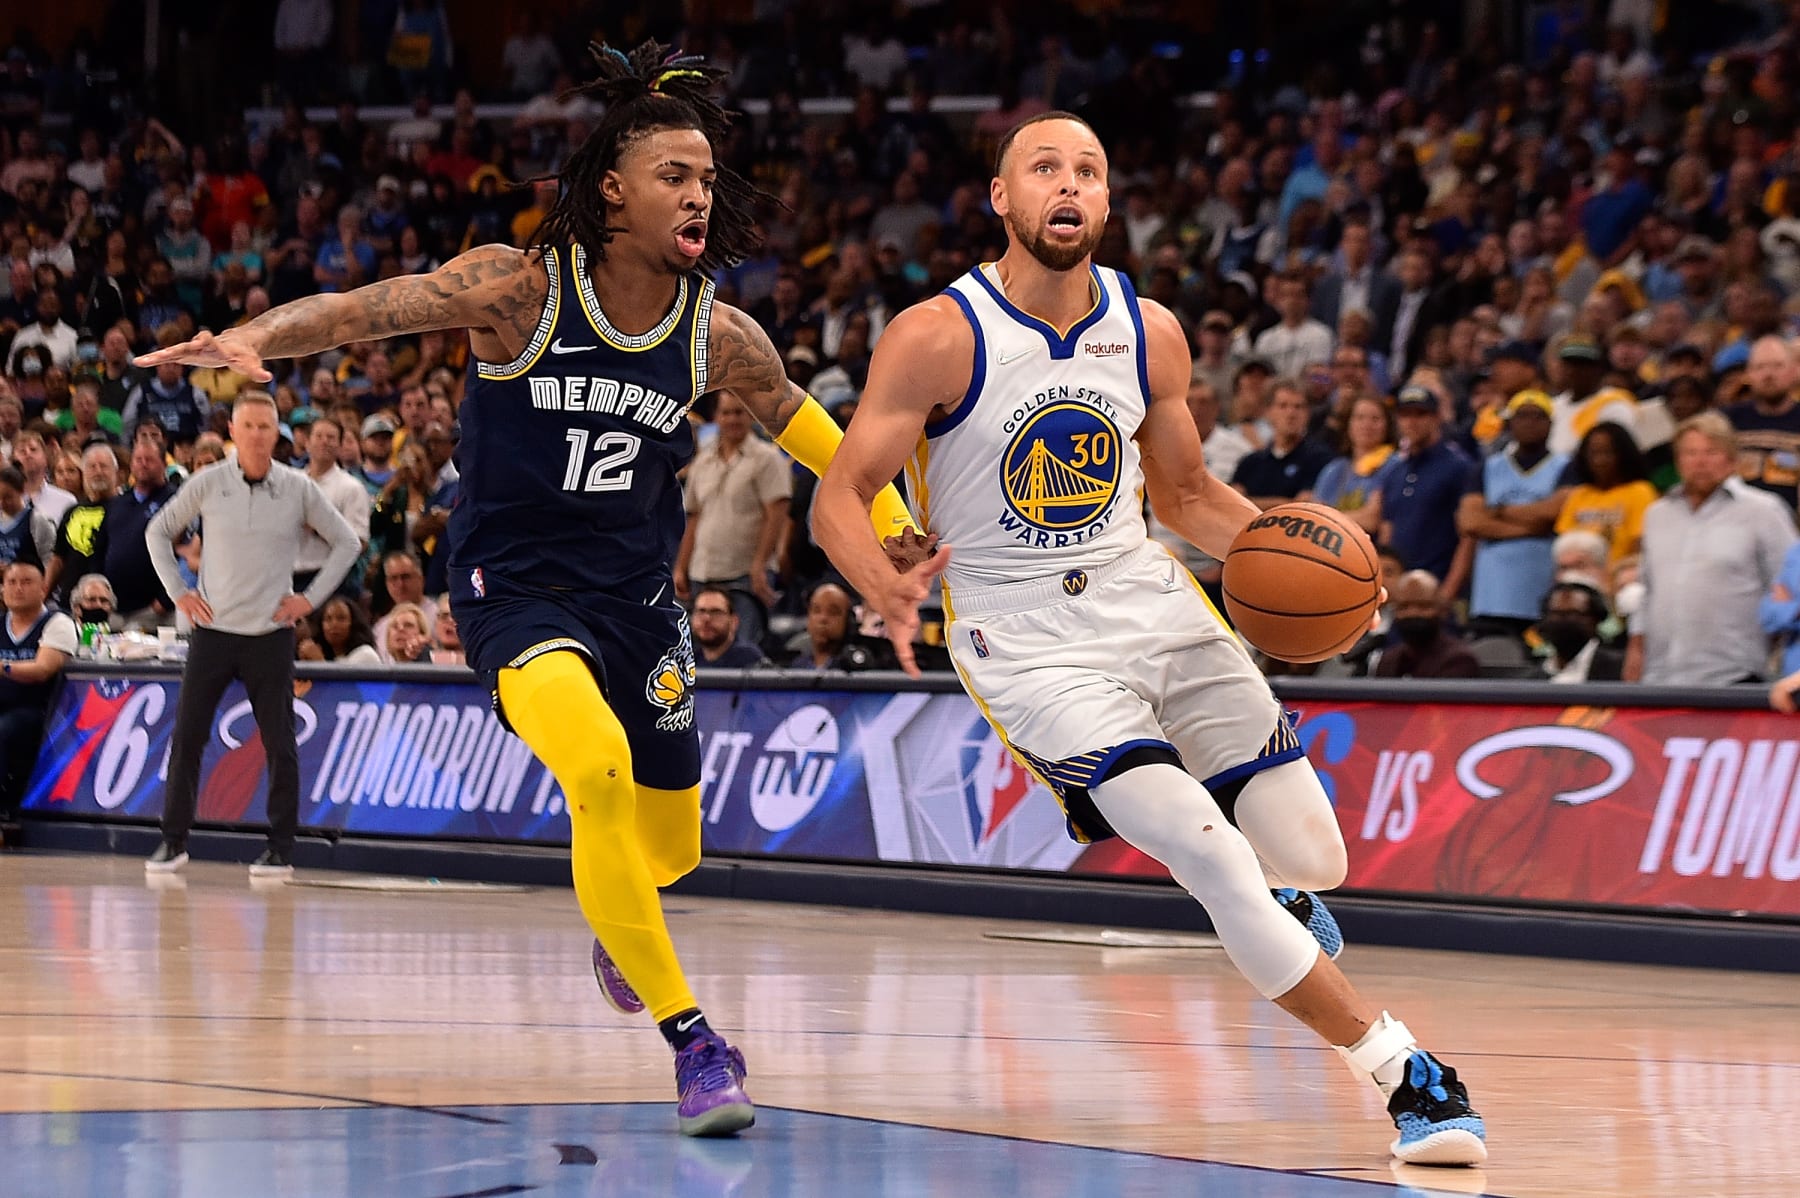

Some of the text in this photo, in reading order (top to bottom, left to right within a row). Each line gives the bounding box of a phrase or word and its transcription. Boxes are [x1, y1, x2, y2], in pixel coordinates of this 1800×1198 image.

[1084, 342, 1129, 356] Rakuten
[527, 376, 688, 434] MEMPHIS
[1003, 385, 1119, 434] GOLDEN STATE
[562, 428, 642, 492] 12
[1069, 432, 1110, 469] 30
[998, 494, 1121, 549] WARRIOR
[1246, 515, 1344, 557] Wilson
[310, 701, 533, 814] TOMORROW
[1360, 750, 1434, 843] VS
